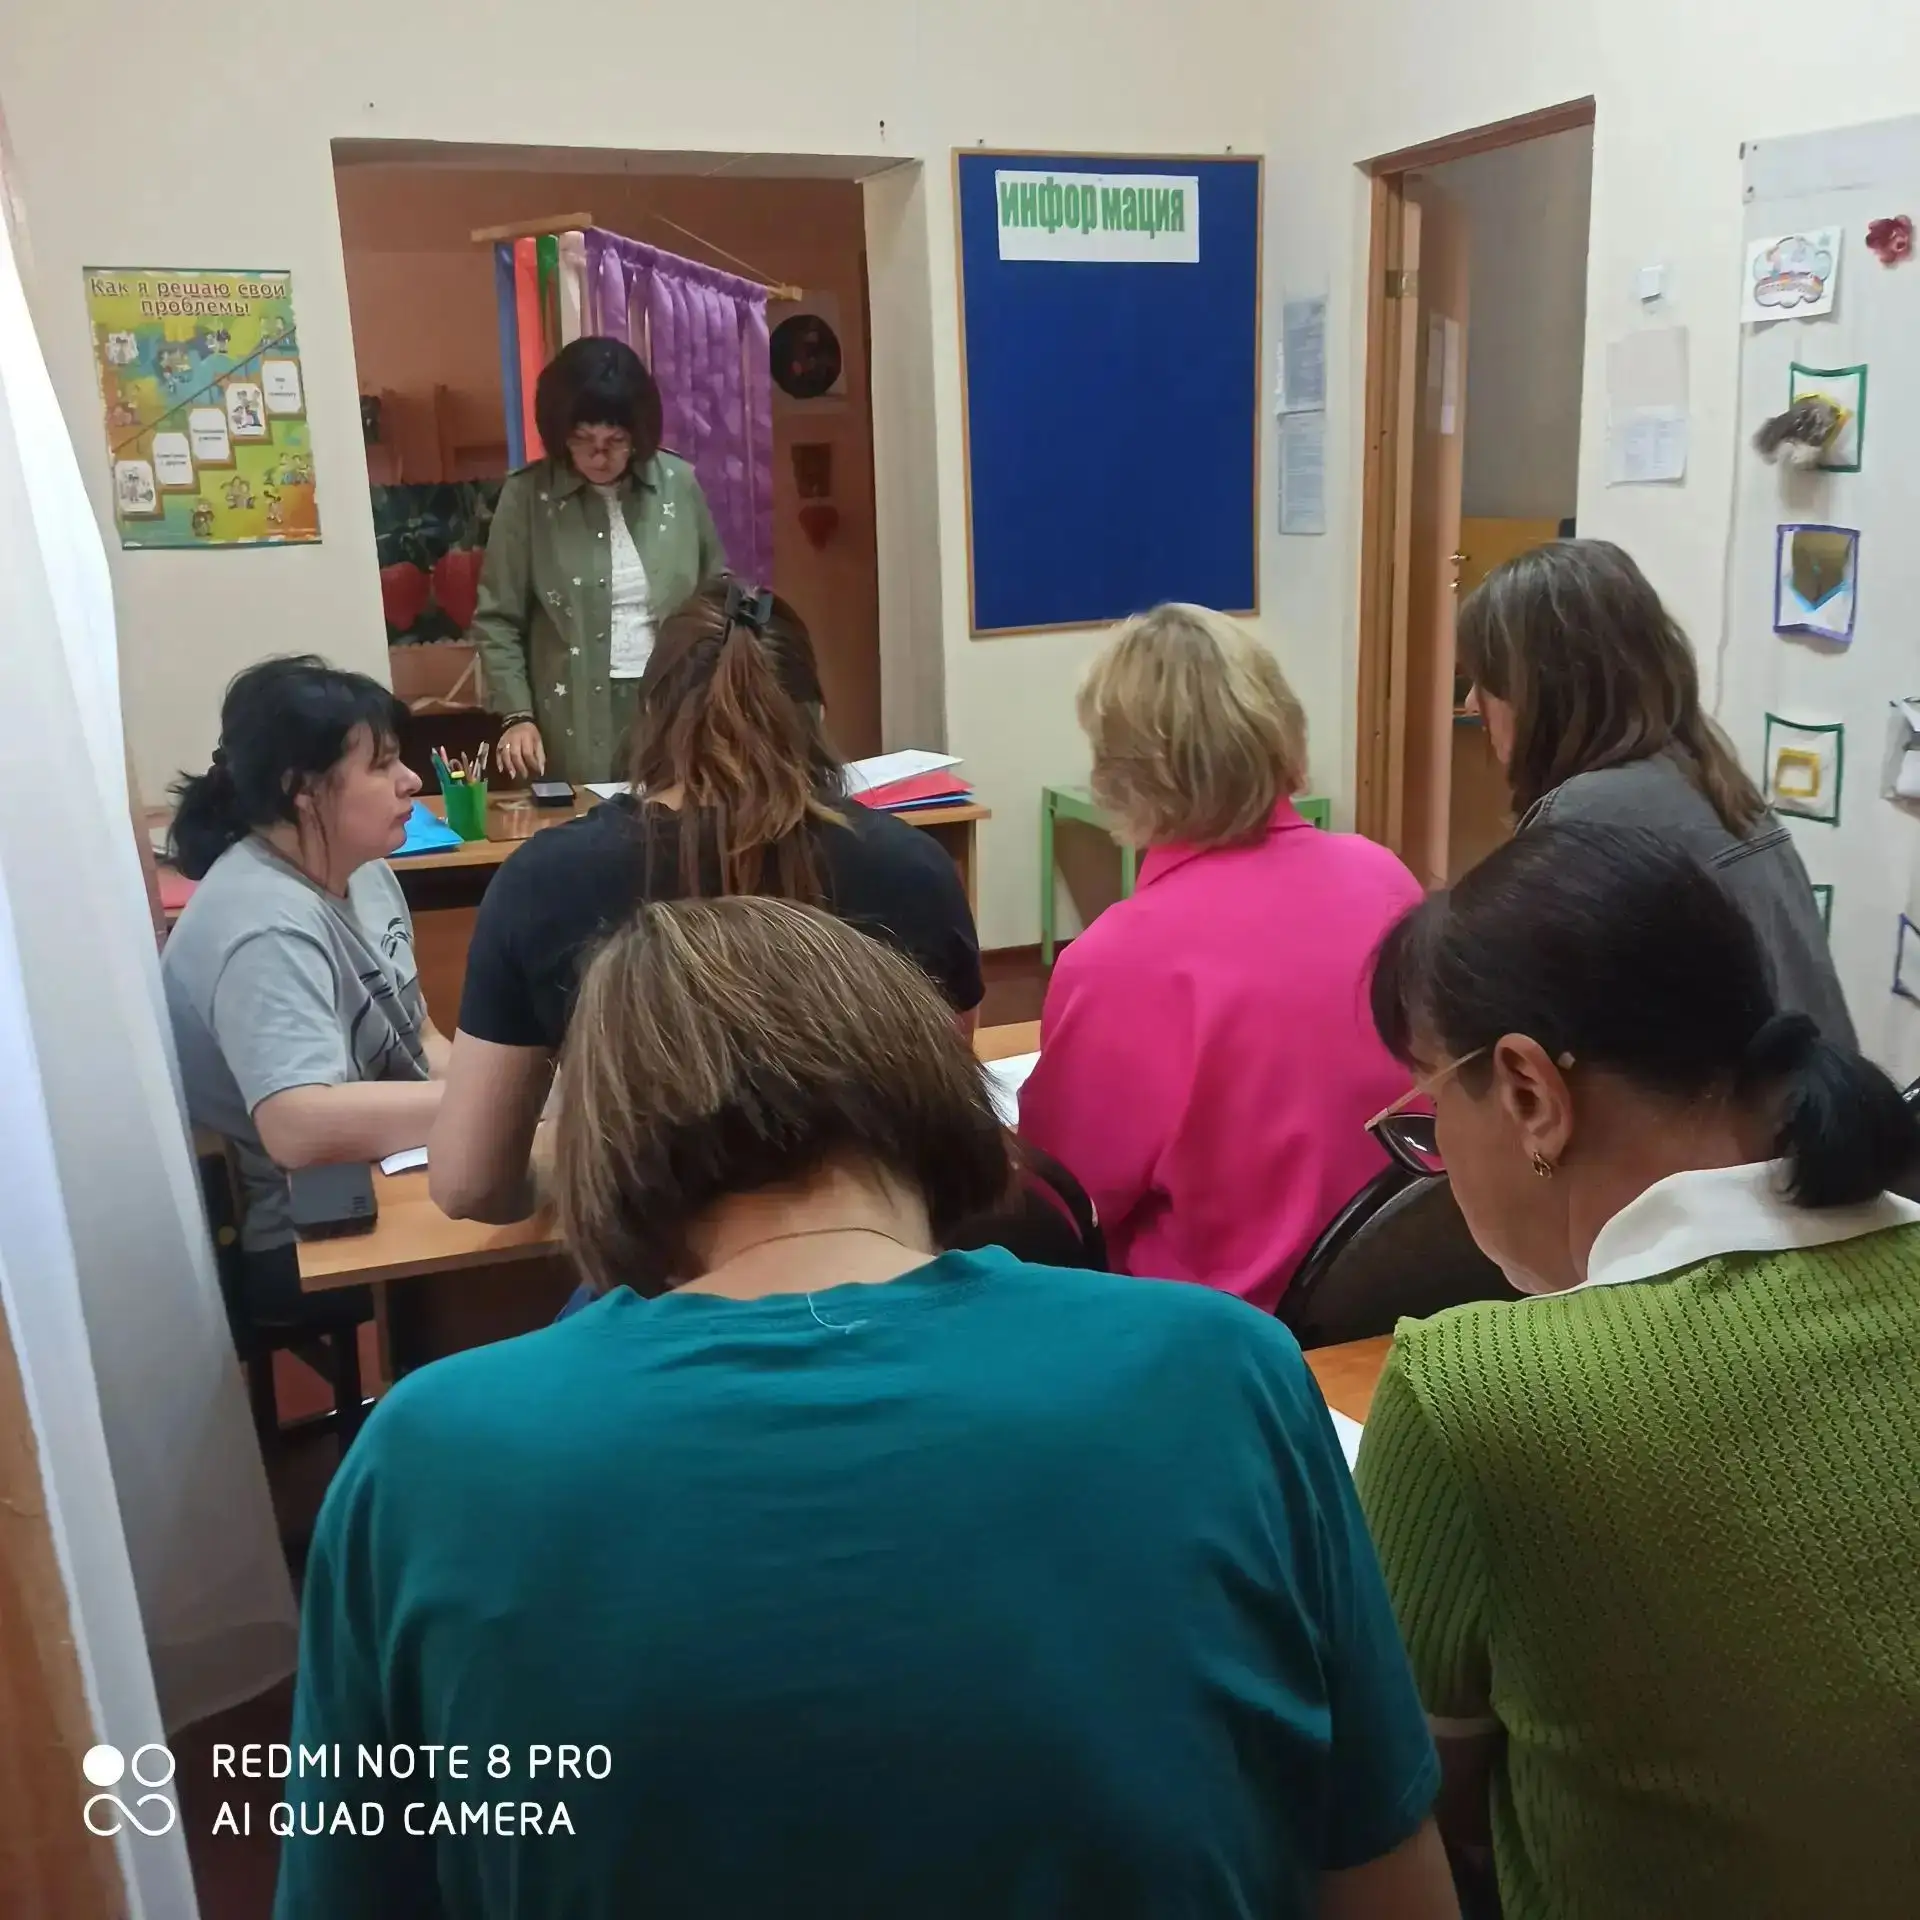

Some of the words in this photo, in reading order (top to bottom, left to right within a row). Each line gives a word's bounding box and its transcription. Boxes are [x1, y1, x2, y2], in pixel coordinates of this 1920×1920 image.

[90, 278, 129, 296] Как
[138, 281, 149, 297] я
[157, 281, 231, 299] решаю
[237, 283, 286, 299] свои
[141, 298, 250, 317] проблемы
